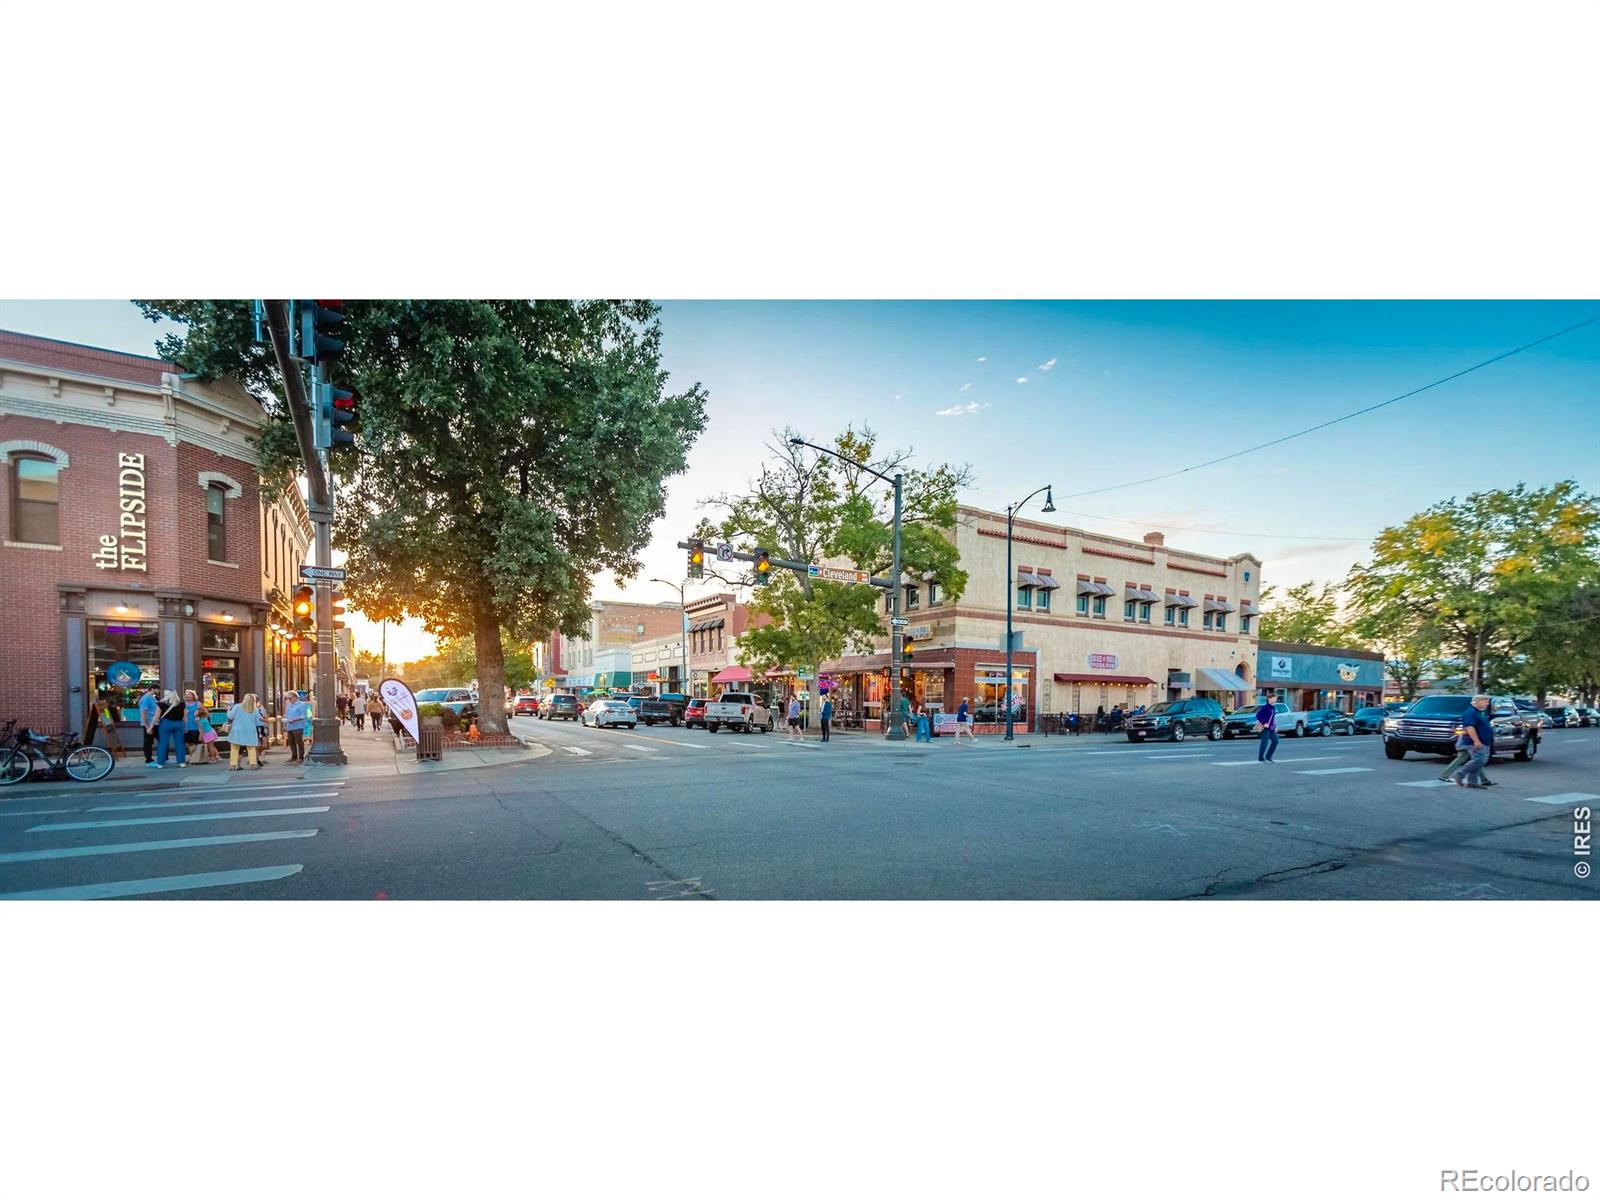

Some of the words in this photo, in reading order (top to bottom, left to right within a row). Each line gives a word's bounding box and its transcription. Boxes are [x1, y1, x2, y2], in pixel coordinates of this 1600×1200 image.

[119, 452, 147, 572] FLIPSIDE
[92, 534, 118, 569] the
[823, 568, 858, 581] Cleveland
